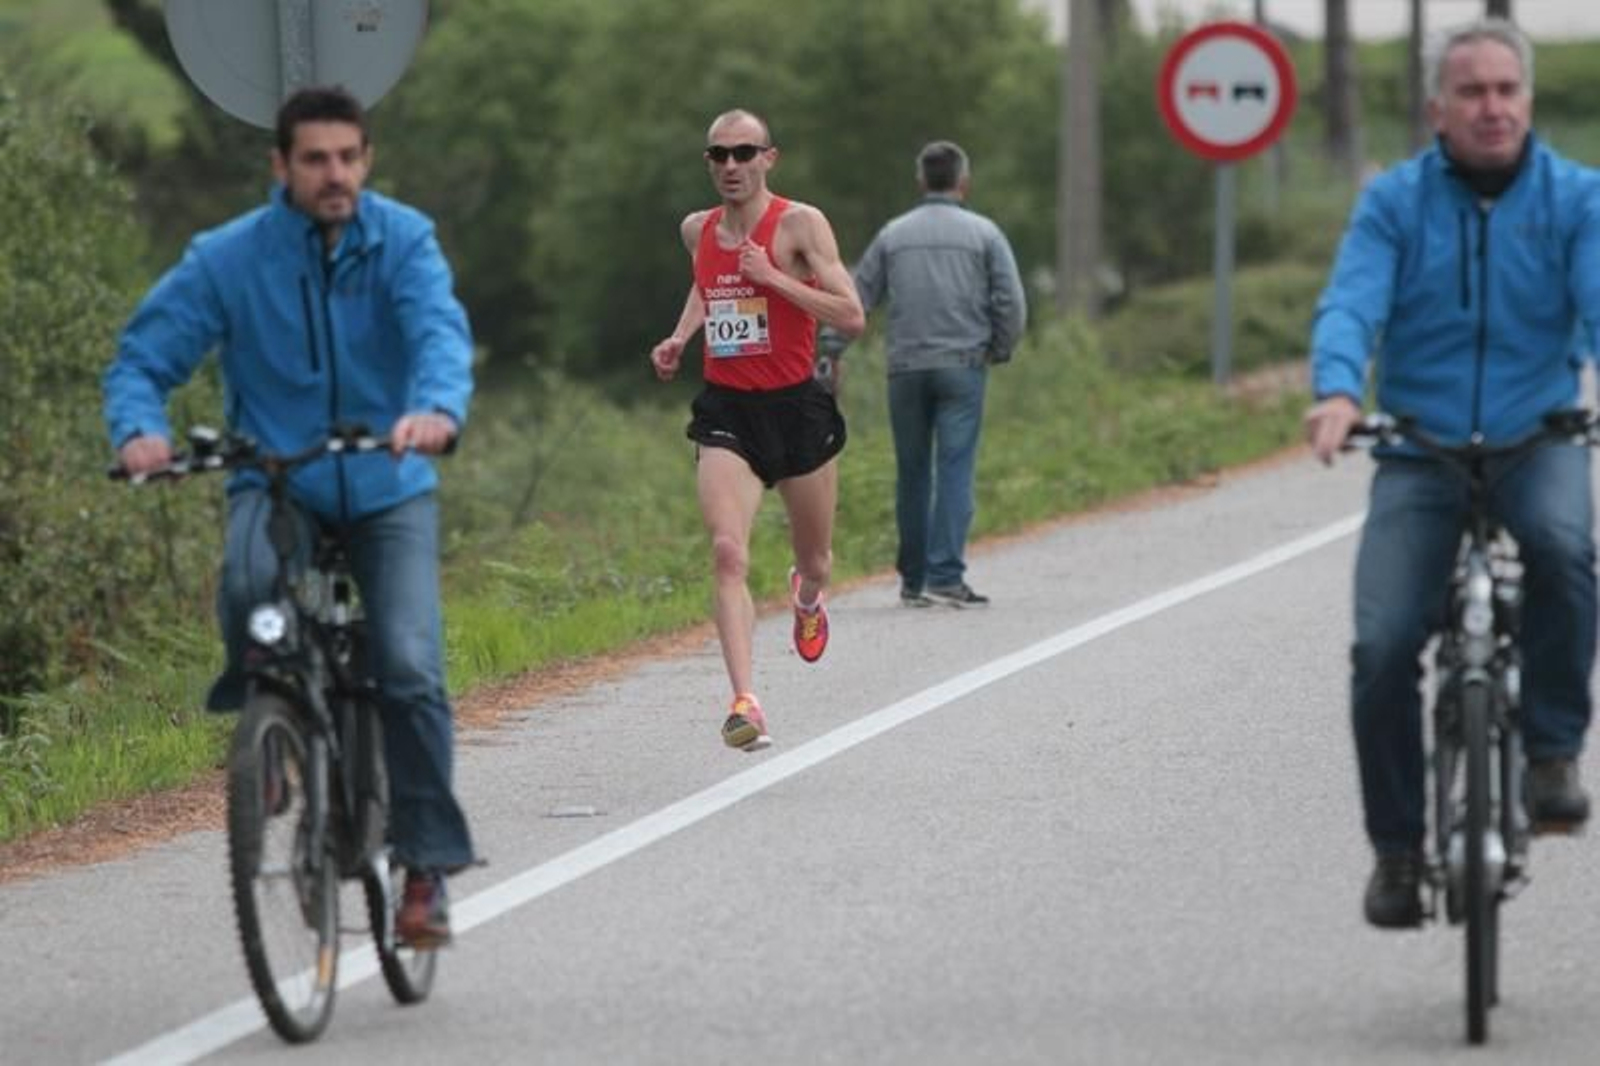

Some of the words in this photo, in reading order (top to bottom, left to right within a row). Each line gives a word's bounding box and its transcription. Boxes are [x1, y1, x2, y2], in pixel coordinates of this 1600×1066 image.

[717, 274, 741, 284] new
[705, 286, 754, 298] balance
[708, 319, 749, 341] 702
